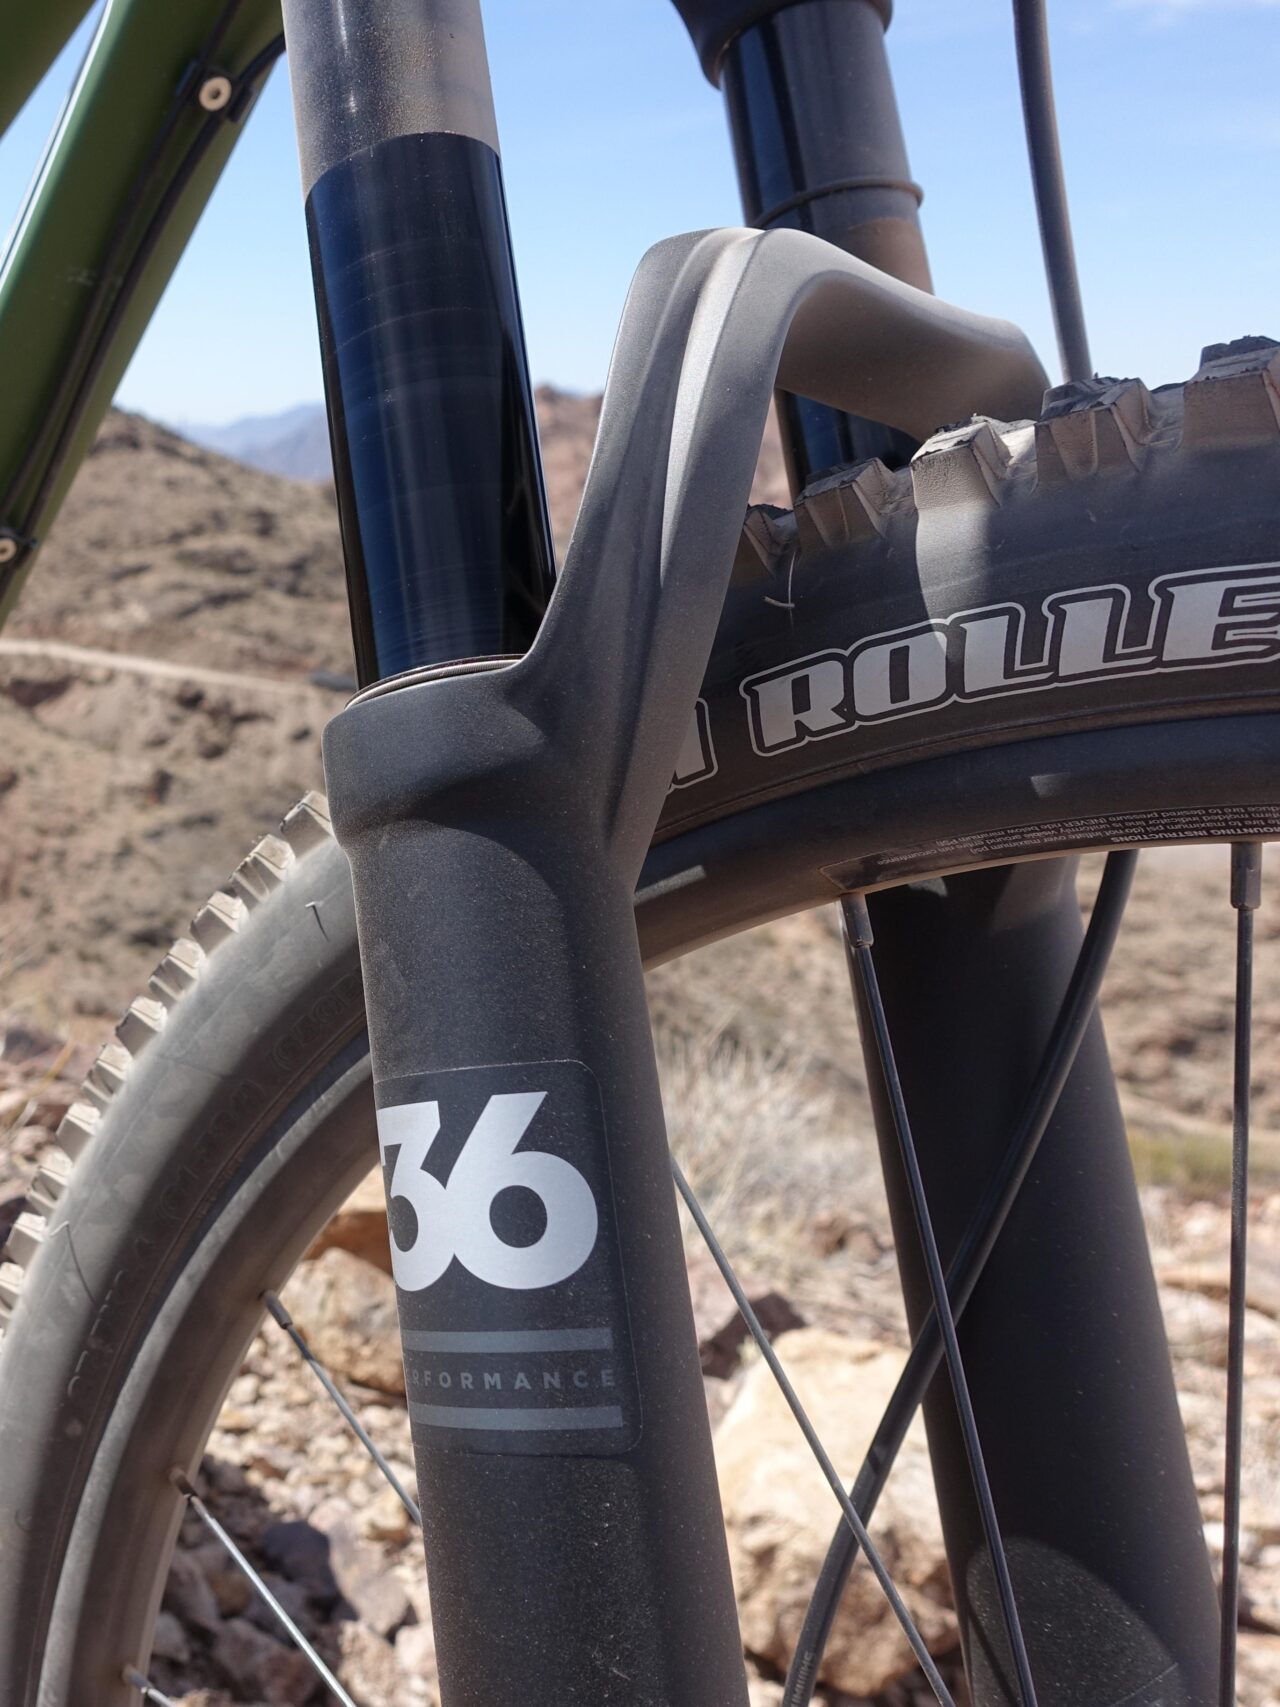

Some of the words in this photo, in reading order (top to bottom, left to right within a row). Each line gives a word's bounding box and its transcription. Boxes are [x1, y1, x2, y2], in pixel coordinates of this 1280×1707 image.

[739, 562, 1280, 757] ROLLE
[1166, 822, 1226, 831] maximum
[990, 839, 1041, 850] maximum
[1110, 830, 1208, 843] INSTRUCTIONS
[376, 1091, 598, 1292] 36
[406, 1368, 617, 1391] RFORMANCE
